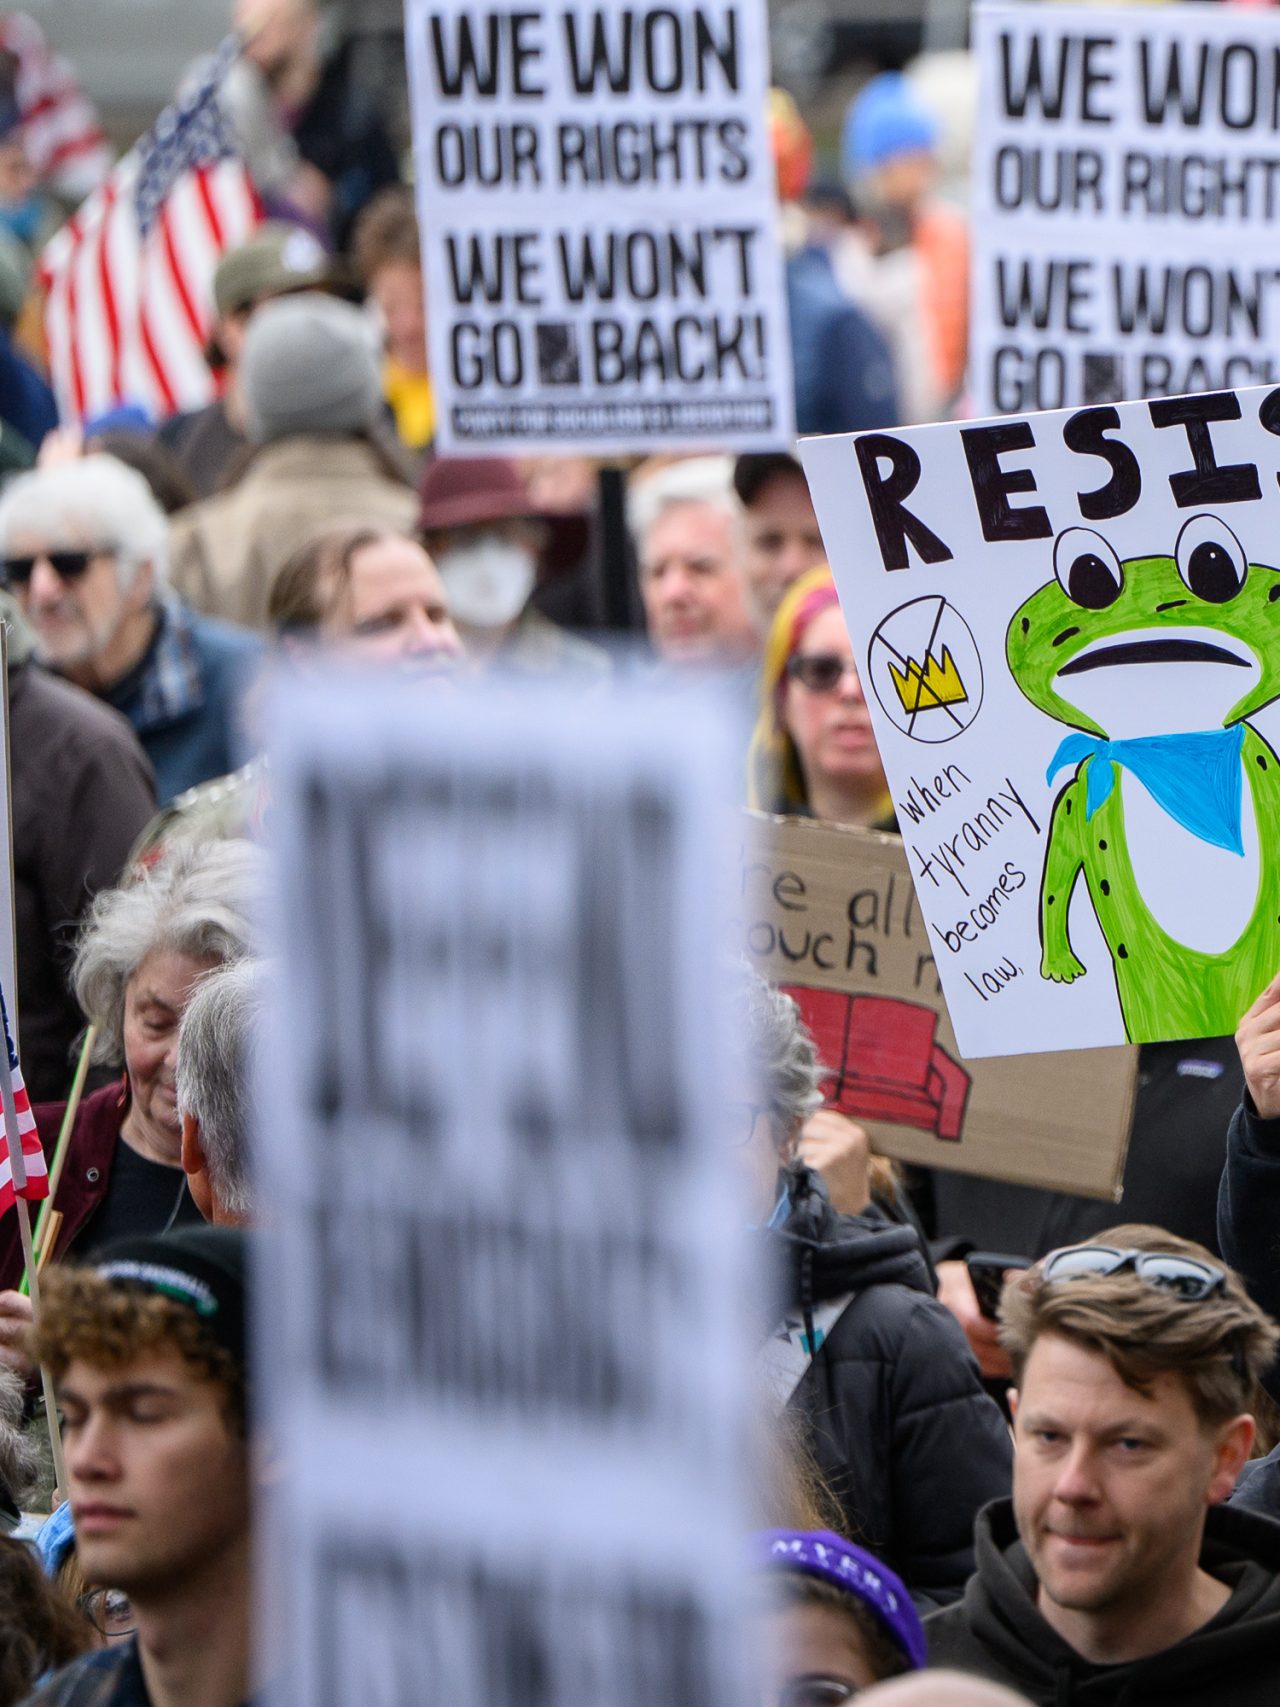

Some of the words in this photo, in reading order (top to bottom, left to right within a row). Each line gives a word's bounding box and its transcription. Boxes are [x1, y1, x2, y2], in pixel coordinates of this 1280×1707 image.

[430, 11, 544, 97] WE
[564, 9, 738, 94] WON
[1000, 32, 1114, 124] WE
[437, 122, 541, 188] OUR
[558, 118, 749, 184] RIGHTS
[996, 145, 1103, 211] OUR
[446, 232, 541, 305] WE
[558, 228, 757, 301] WON'T
[997, 258, 1092, 333] WE
[452, 321, 523, 390] GO
[591, 314, 766, 384] BACK!
[994, 346, 1065, 412] GO
[912, 778, 1041, 896] tyranny
[848, 872, 915, 938] all
[932, 862, 1026, 953] becomes
[747, 920, 878, 976] ouch
